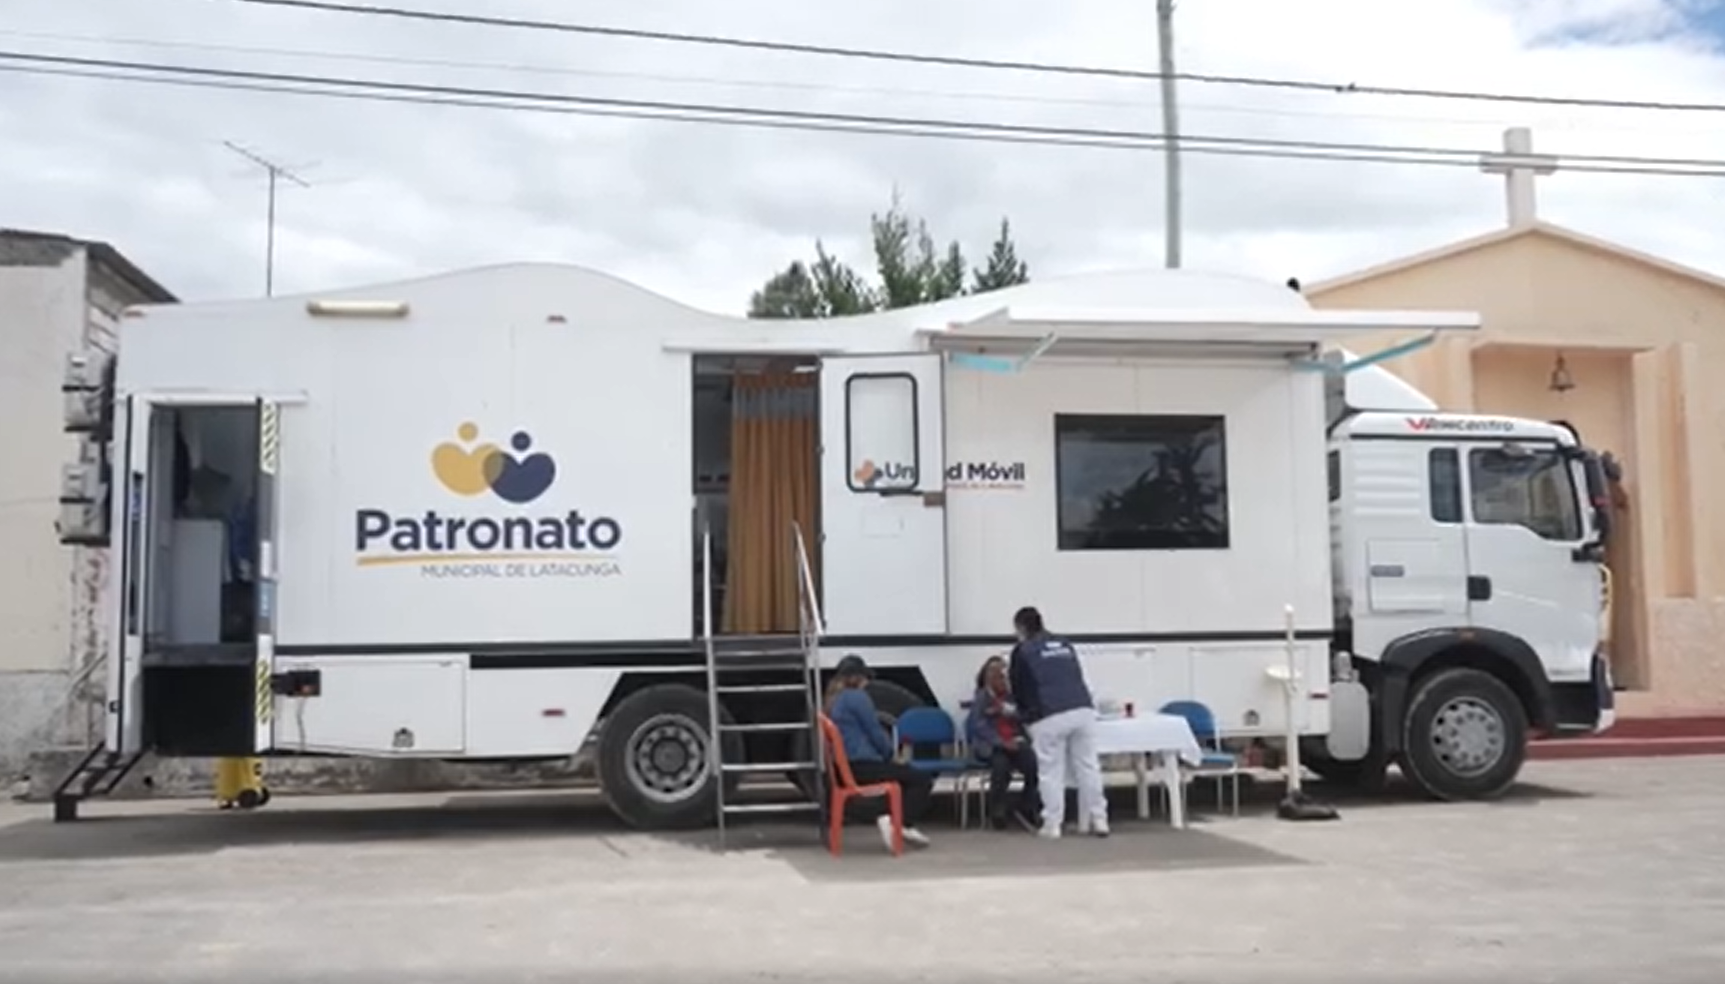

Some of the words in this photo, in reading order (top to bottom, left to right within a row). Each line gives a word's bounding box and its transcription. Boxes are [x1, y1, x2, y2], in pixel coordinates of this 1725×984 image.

[968, 461, 1025, 480] Móvil
[356, 508, 622, 551] Patronato
[421, 564, 503, 577] MUNICIPAL
[507, 563, 524, 577] DE
[527, 562, 622, 577] LATACUNGA
